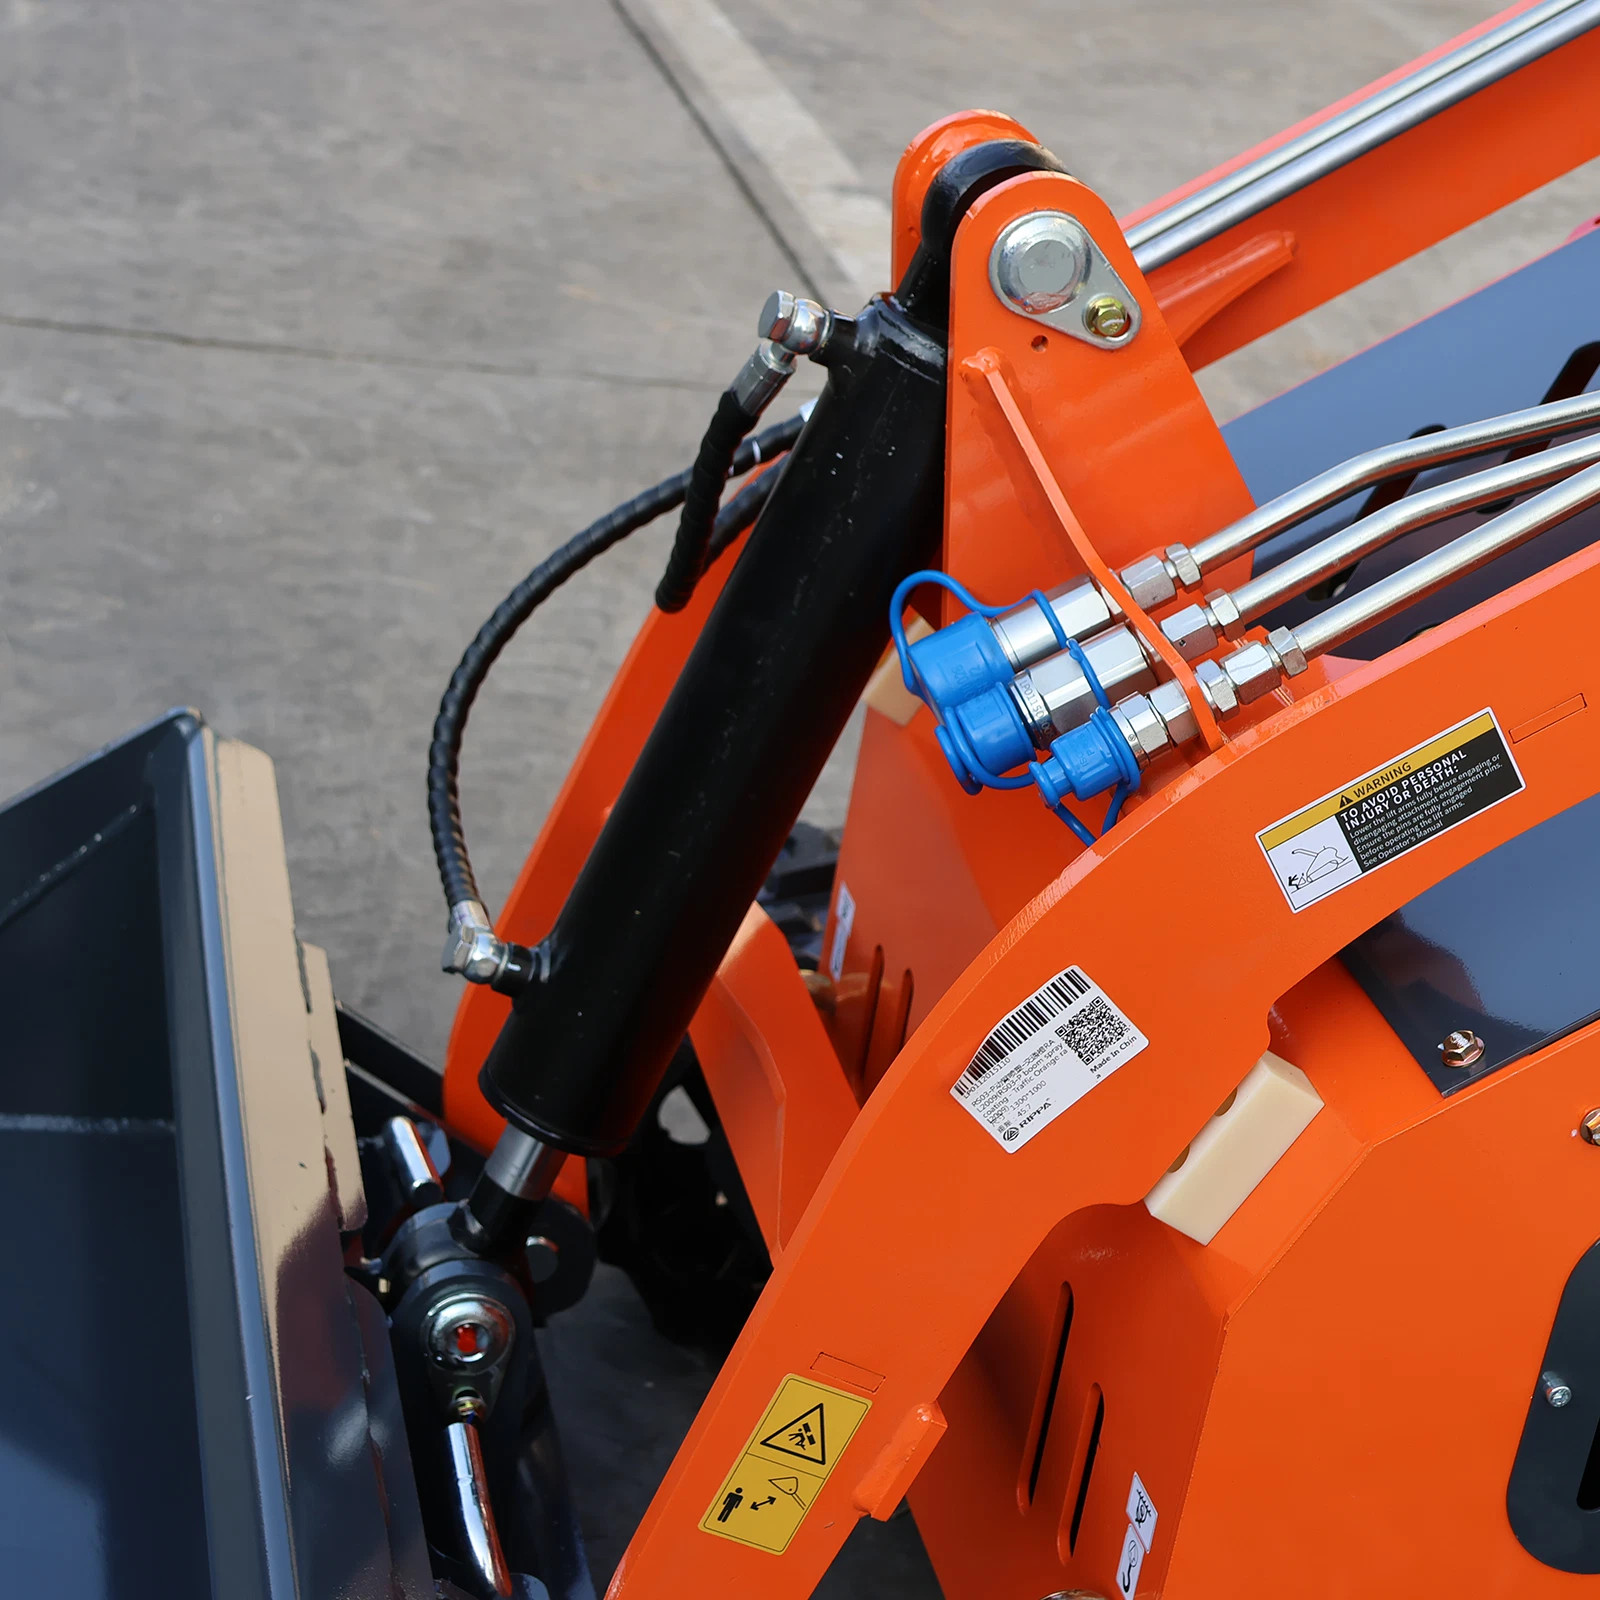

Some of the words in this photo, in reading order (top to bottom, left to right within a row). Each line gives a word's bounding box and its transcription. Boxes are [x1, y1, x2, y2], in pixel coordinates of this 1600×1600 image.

[1340, 808, 1358, 821] TO
[1362, 786, 1398, 812] AVOID
[1401, 750, 1467, 789] PERSONAL
[1345, 800, 1389, 830] INJURY
[1394, 790, 1411, 804] OR
[1414, 766, 1458, 793] DEATH:
[1350, 823, 1372, 839] Lower
[1373, 816, 1385, 826] the
[1386, 810, 1397, 819] lift
[1398, 800, 1416, 813] arms
[1416, 791, 1432, 802] fully
[1433, 778, 1457, 793] before
[1458, 759, 1492, 780] engaging
[1492, 754, 1499, 762] or
[1353, 762, 1411, 798] WARNING
[1354, 819, 1397, 845] disengaging
[1398, 796, 1439, 822] attachment
[1439, 771, 1484, 799] engagement
[1484, 763, 1502, 776] pins.
[1356, 834, 1381, 853] Ensure
[1382, 829, 1394, 839] the
[1394, 820, 1412, 833] pins
[1412, 814, 1424, 823] are
[1424, 804, 1440, 816] fully
[1442, 786, 1472, 807] engaged
[1360, 844, 1384, 860] before
[1385, 825, 1420, 847] operating
[1419, 818, 1432, 828] the
[1432, 810, 1443, 821] lift
[1445, 798, 1465, 814] arms.
[1363, 857, 1377, 867] See
[1378, 836, 1416, 859] Operator's
[1416, 820, 1443, 839] Manual
[962, 1056, 1012, 1099] LP0112015110
[1022, 1058, 1044, 1076] boom
[1044, 1043, 1063, 1059] spray
[1090, 1057, 1110, 1073] Made
[1117, 1034, 1137, 1051] Chin
[983, 1097, 1009, 1118] coating
[1012, 1076, 1034, 1093] Traffic
[1033, 1056, 1060, 1077] Orange
